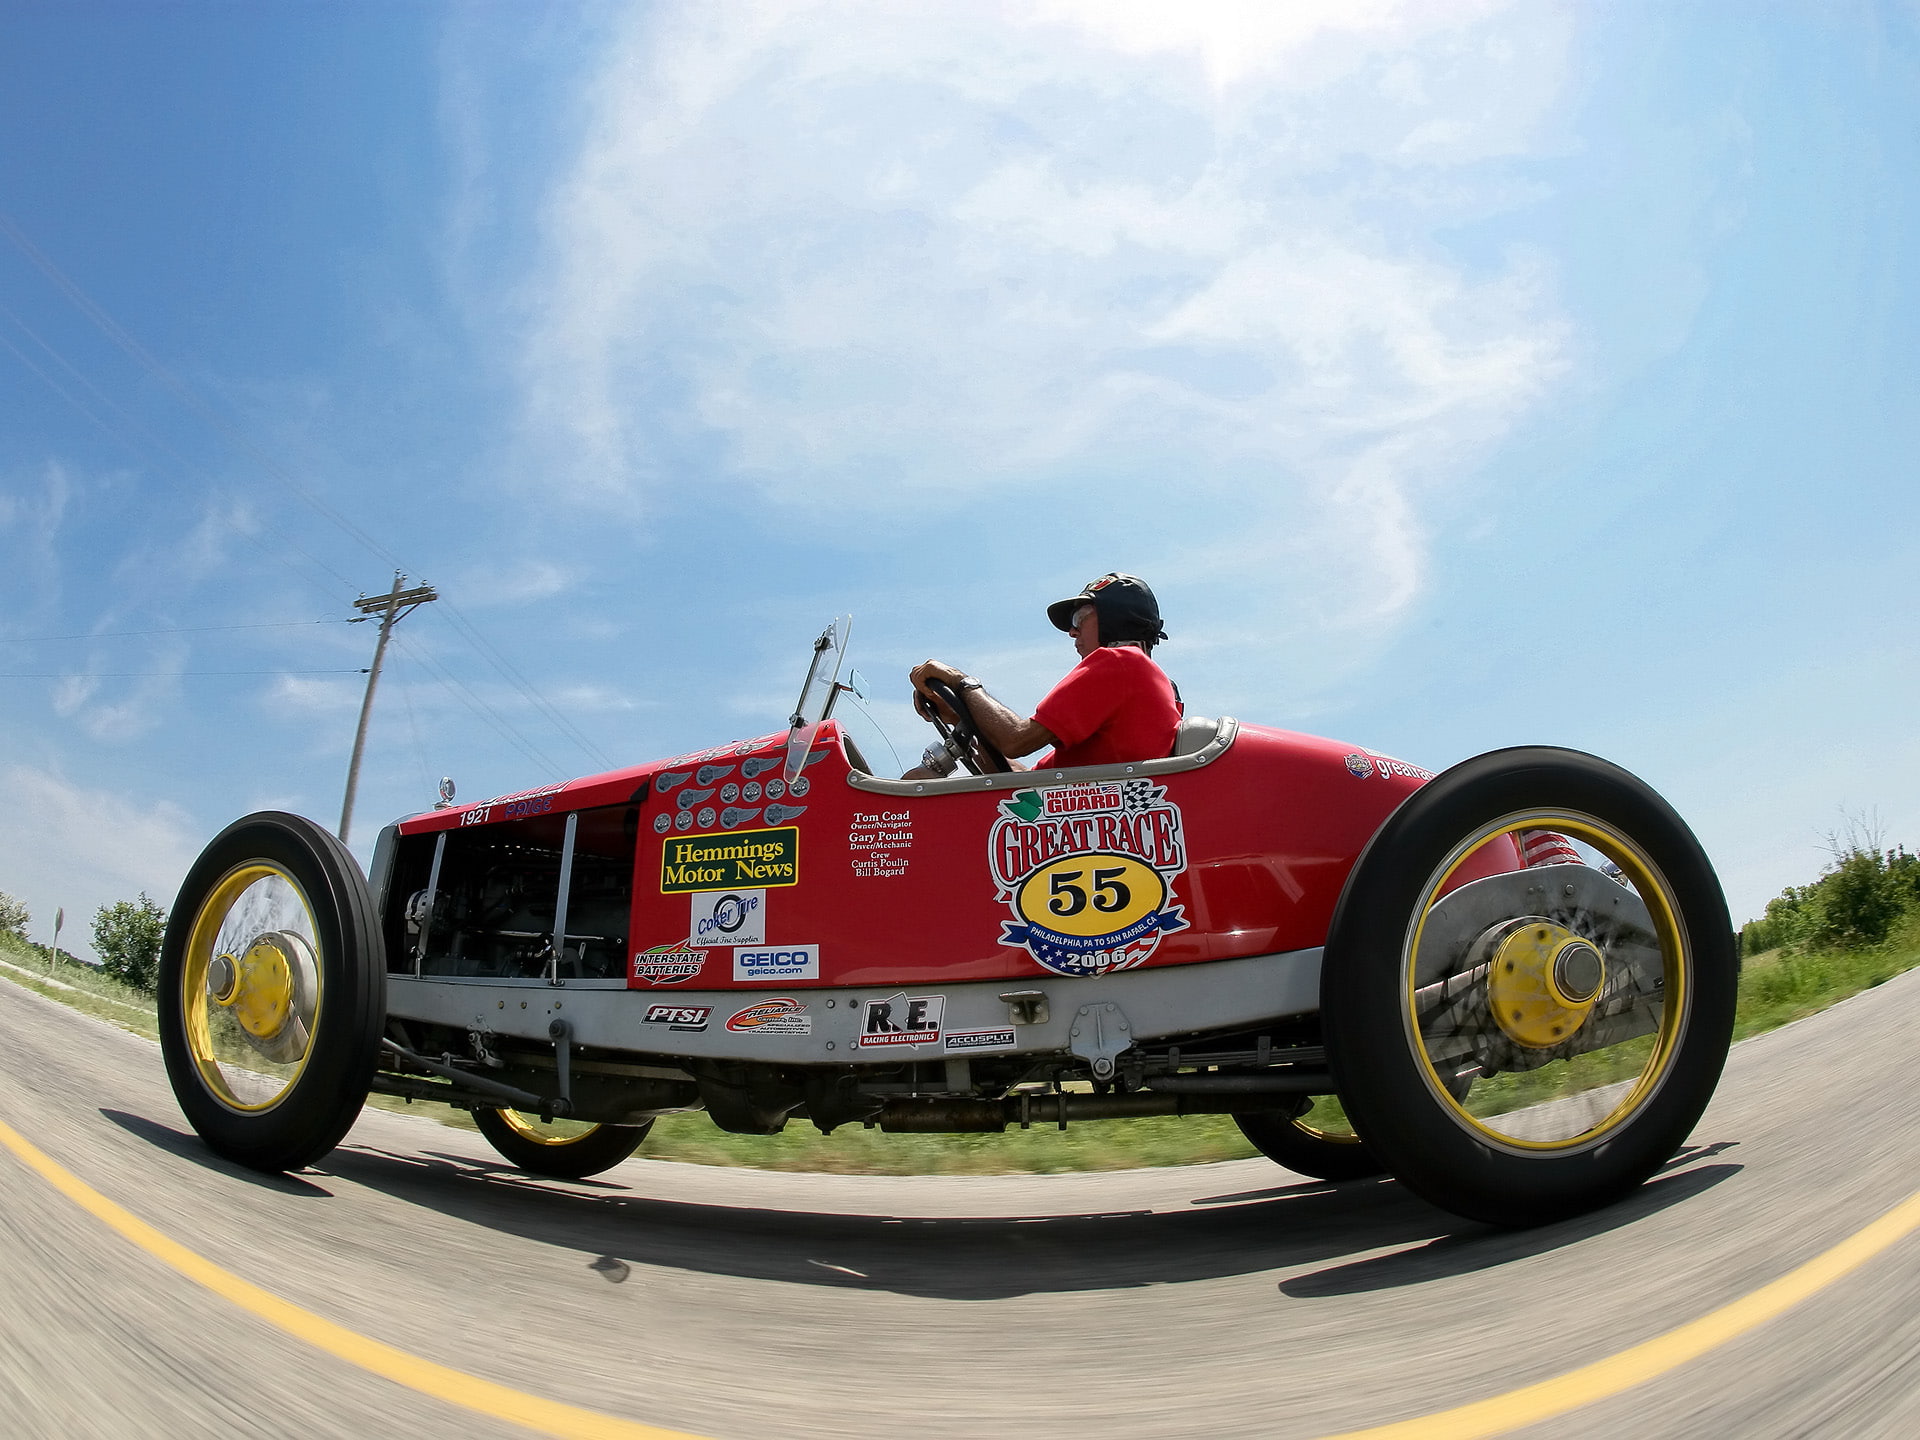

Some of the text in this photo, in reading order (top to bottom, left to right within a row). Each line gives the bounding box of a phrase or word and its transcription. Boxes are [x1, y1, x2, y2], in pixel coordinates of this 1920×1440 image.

[1047, 787, 1103, 799] NATIONAL
[505, 796, 554, 818] PAIGE
[1047, 794, 1120, 813] GUARD
[459, 808, 491, 826] 1921
[854, 810, 910, 822] Tom Coad
[851, 821, 912, 830] Owner/Navigator
[849, 830, 913, 843] Gary Poulin
[675, 839, 784, 863] Hemmings
[850, 841, 911, 850] Driver/Mechanic
[996, 809, 1178, 881] GREAT RACE
[871, 851, 891, 859] Crew
[851, 858, 909, 868] Curtis Poulin
[664, 859, 793, 885] Motor News
[856, 867, 905, 877] Bill Bogard
[1047, 867, 1131, 917] 55
[698, 896, 758, 935] Coker Tire
[1030, 926, 1083, 948] PHILADELPHIA,
[1084, 939, 1093, 947] PA
[1095, 938, 1105, 946] TO
[1106, 934, 1122, 945] SAN
[1146, 916, 1158, 926] CA
[696, 936, 719, 946] Official
[636, 953, 703, 964] INTERSTATE
[740, 951, 809, 967] GEICO
[1066, 948, 1127, 968] 2006
[637, 964, 699, 975] BATTERIES
[747, 966, 803, 977] geico.com
[649, 1008, 705, 1023] PTSI
[748, 1006, 802, 1018] RELIABLE
[864, 1033, 935, 1044] RACING ELECTRONICS
[948, 1033, 1013, 1044] ACCUSPLIT
